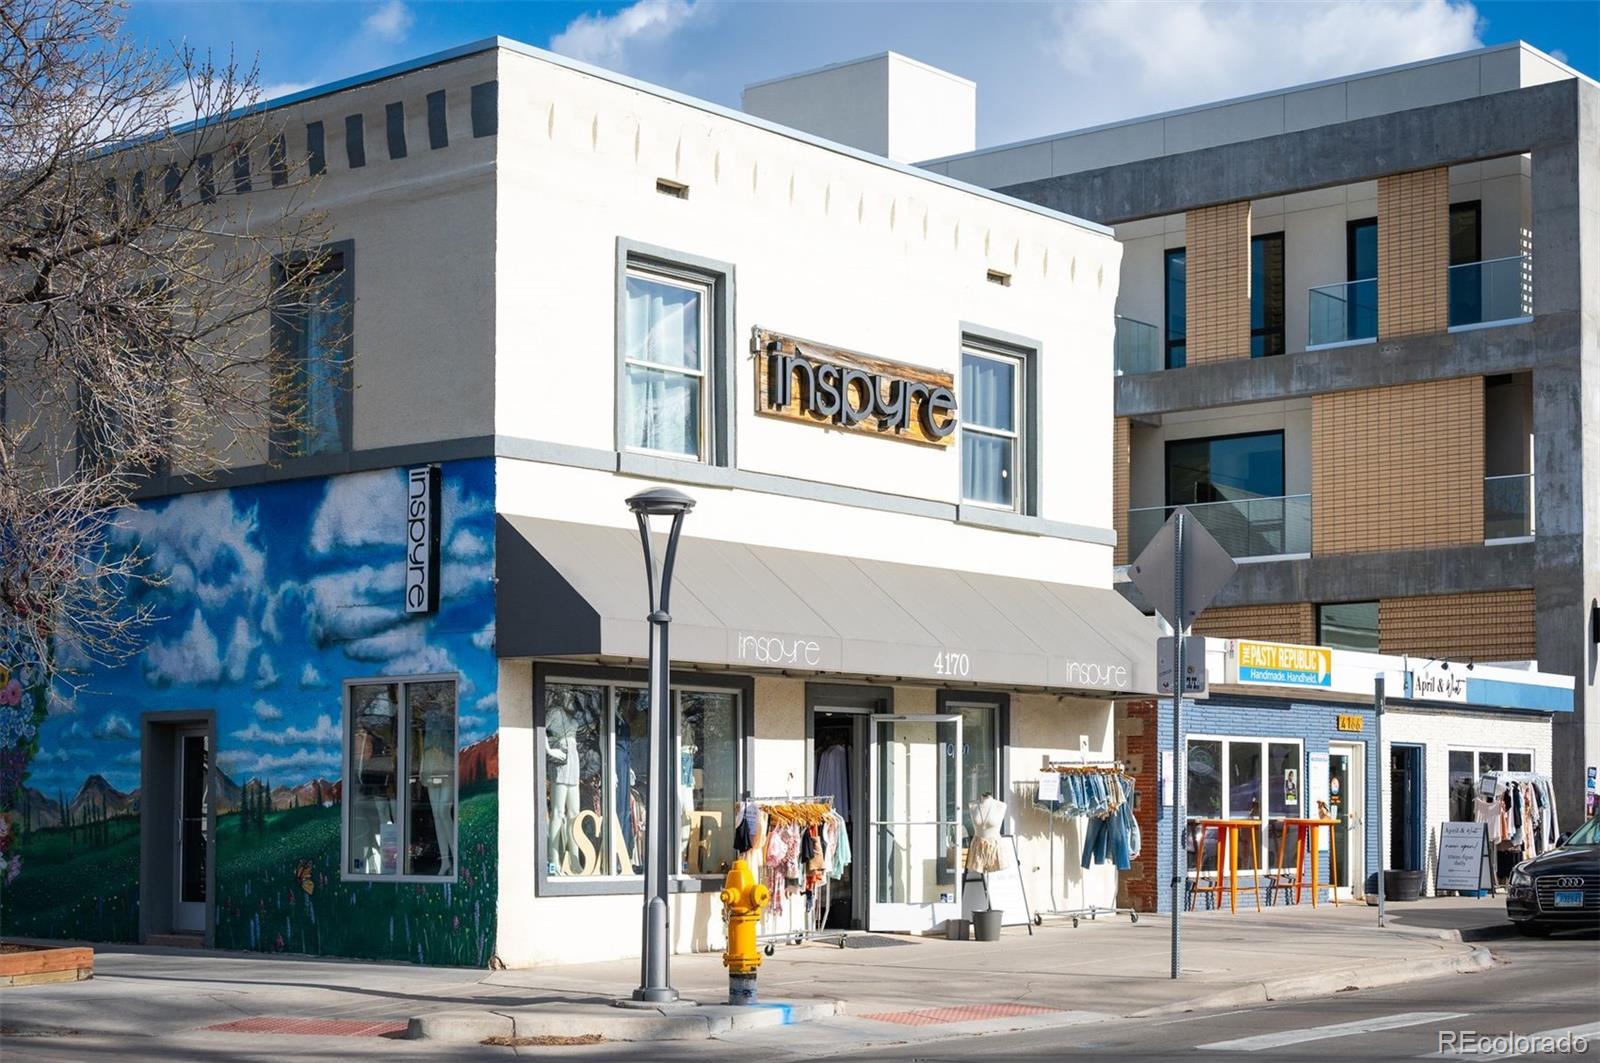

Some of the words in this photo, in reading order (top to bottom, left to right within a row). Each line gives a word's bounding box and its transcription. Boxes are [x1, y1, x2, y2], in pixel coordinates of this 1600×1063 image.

[768, 341, 958, 440] inspyre
[408, 470, 430, 608] inspyre
[737, 632, 820, 665] inspyre
[1250, 646, 1277, 667] PASTY
[1279, 648, 1317, 670] REPUBLIC
[933, 652, 969, 677] 4170
[1066, 659, 1127, 687] inspyre
[1415, 675, 1435, 696] April
[1437, 678, 1444, 693] &
[1341, 716, 1361, 730] 4166
